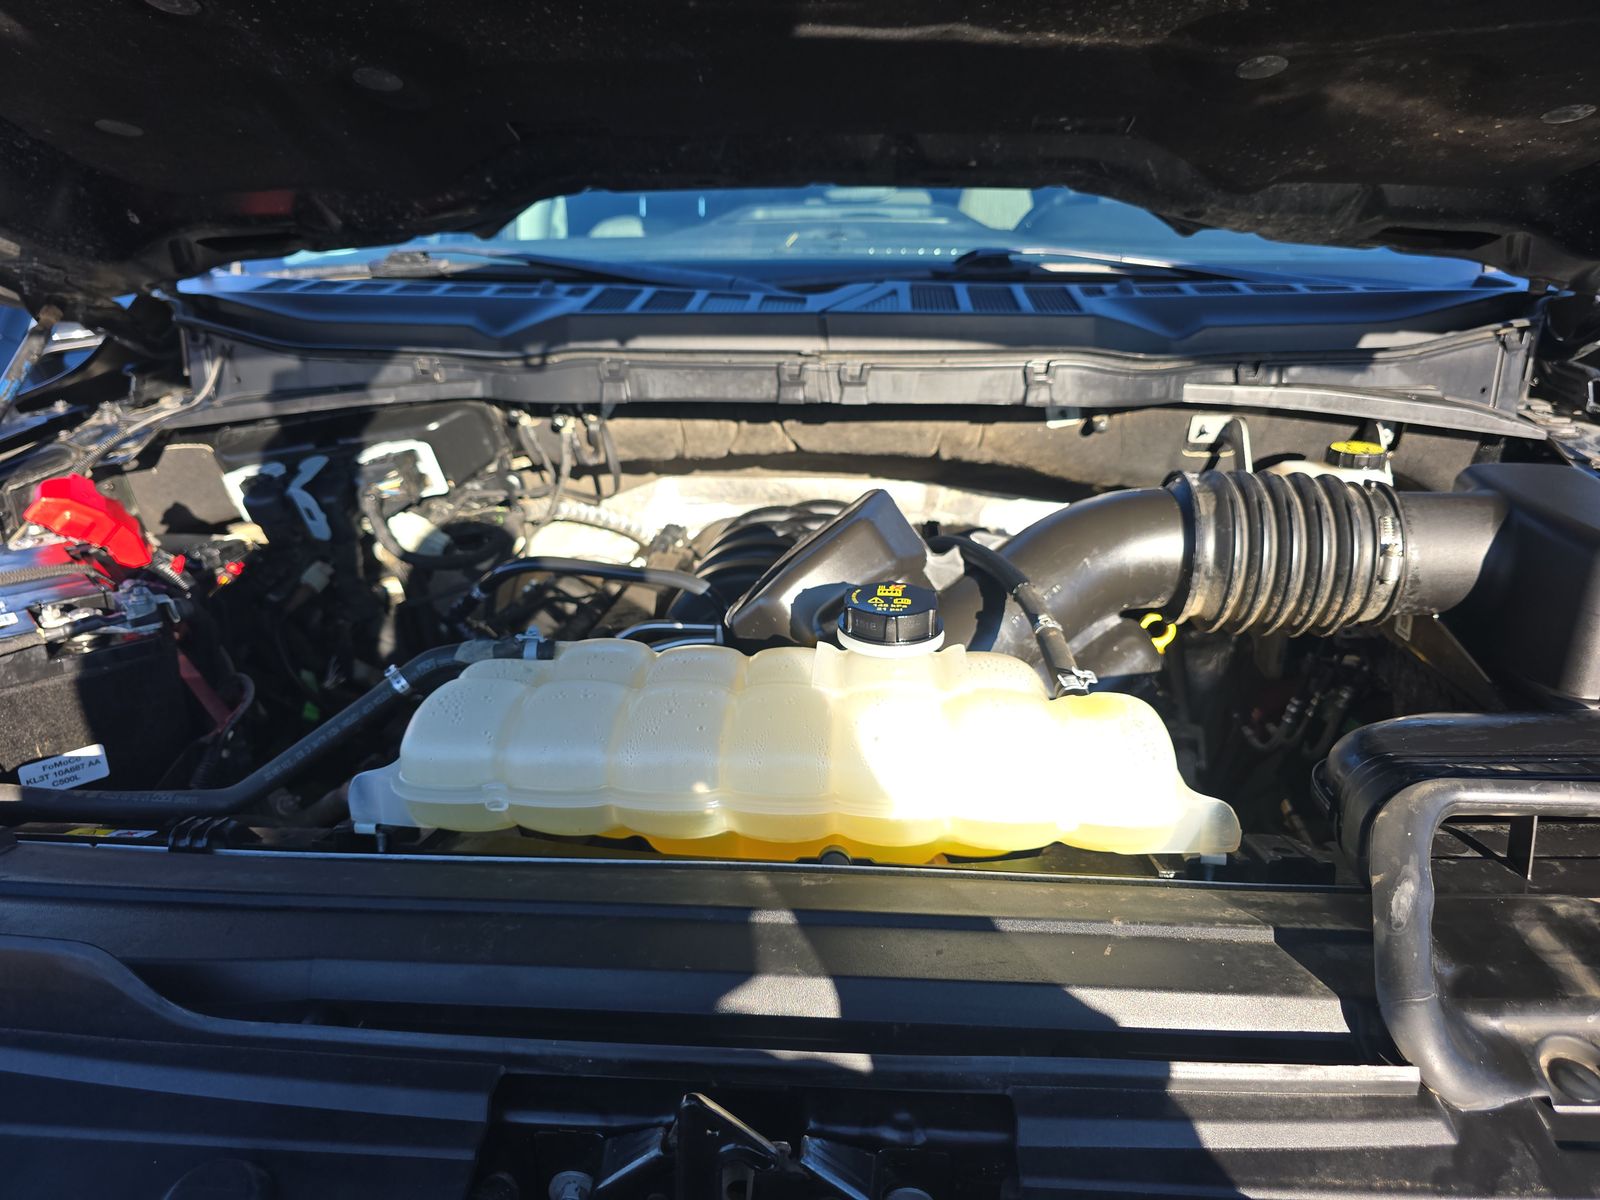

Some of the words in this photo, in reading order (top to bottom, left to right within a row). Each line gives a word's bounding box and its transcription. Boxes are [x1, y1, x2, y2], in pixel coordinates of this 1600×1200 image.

[41, 756, 82, 771] FoMoCo
[26, 773, 50, 785] KL3T
[88, 758, 101, 768] AA
[52, 775, 80, 787] C500L
